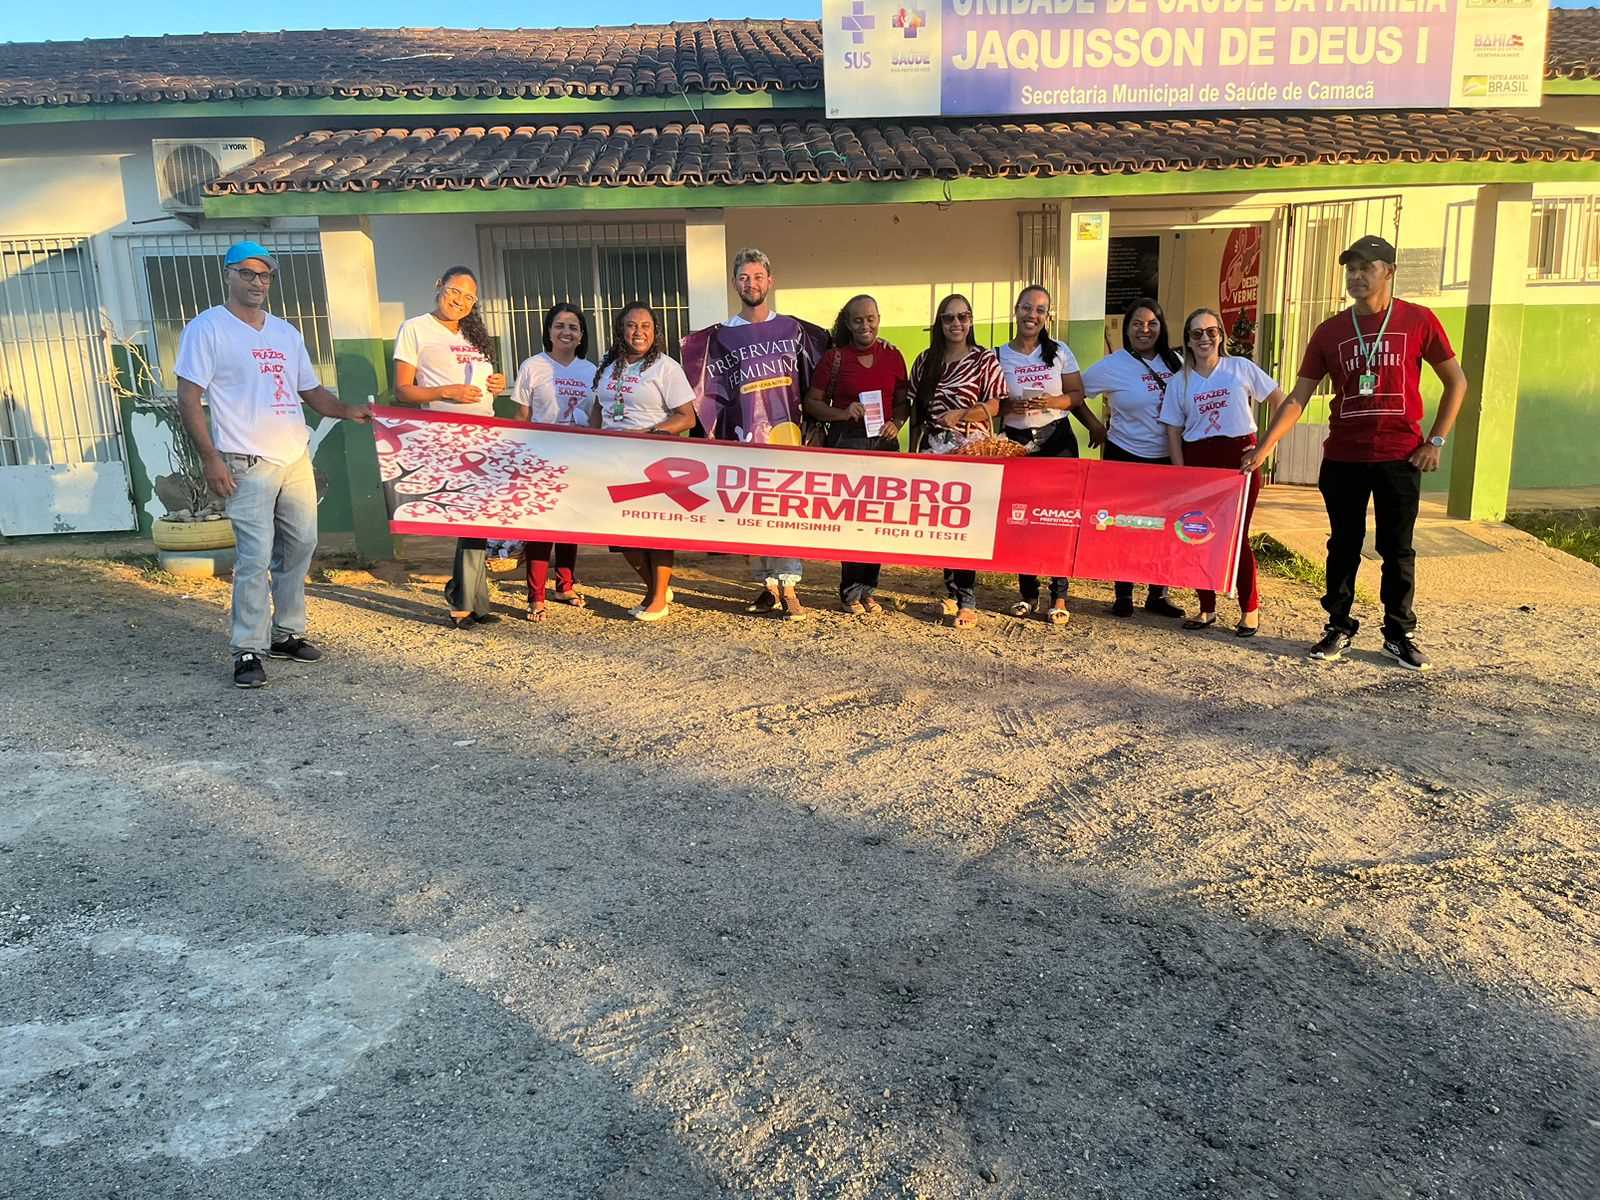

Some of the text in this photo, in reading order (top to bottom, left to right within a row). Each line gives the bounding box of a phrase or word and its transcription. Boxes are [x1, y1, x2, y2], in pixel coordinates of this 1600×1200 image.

[952, 26, 1430, 72] JAQUISSON DE DEUS I
[1474, 34, 1517, 47] BAHIA
[844, 51, 871, 69] SUS
[1021, 80, 1375, 107] Secretaria Municipal de Saúde de Camacã
[1488, 81, 1528, 92] BRASIL
[716, 464, 972, 505] DEZEMBRO
[716, 489, 971, 529] VERMELHO
[1032, 508, 1082, 519] CAMACÃ
[621, 508, 707, 524] PROTEJA-SE
[736, 517, 763, 528] USE
[766, 518, 841, 533] CAMISINHA
[874, 526, 912, 540] FAÇA
[914, 527, 924, 539] O
[928, 529, 968, 542] TESTE
